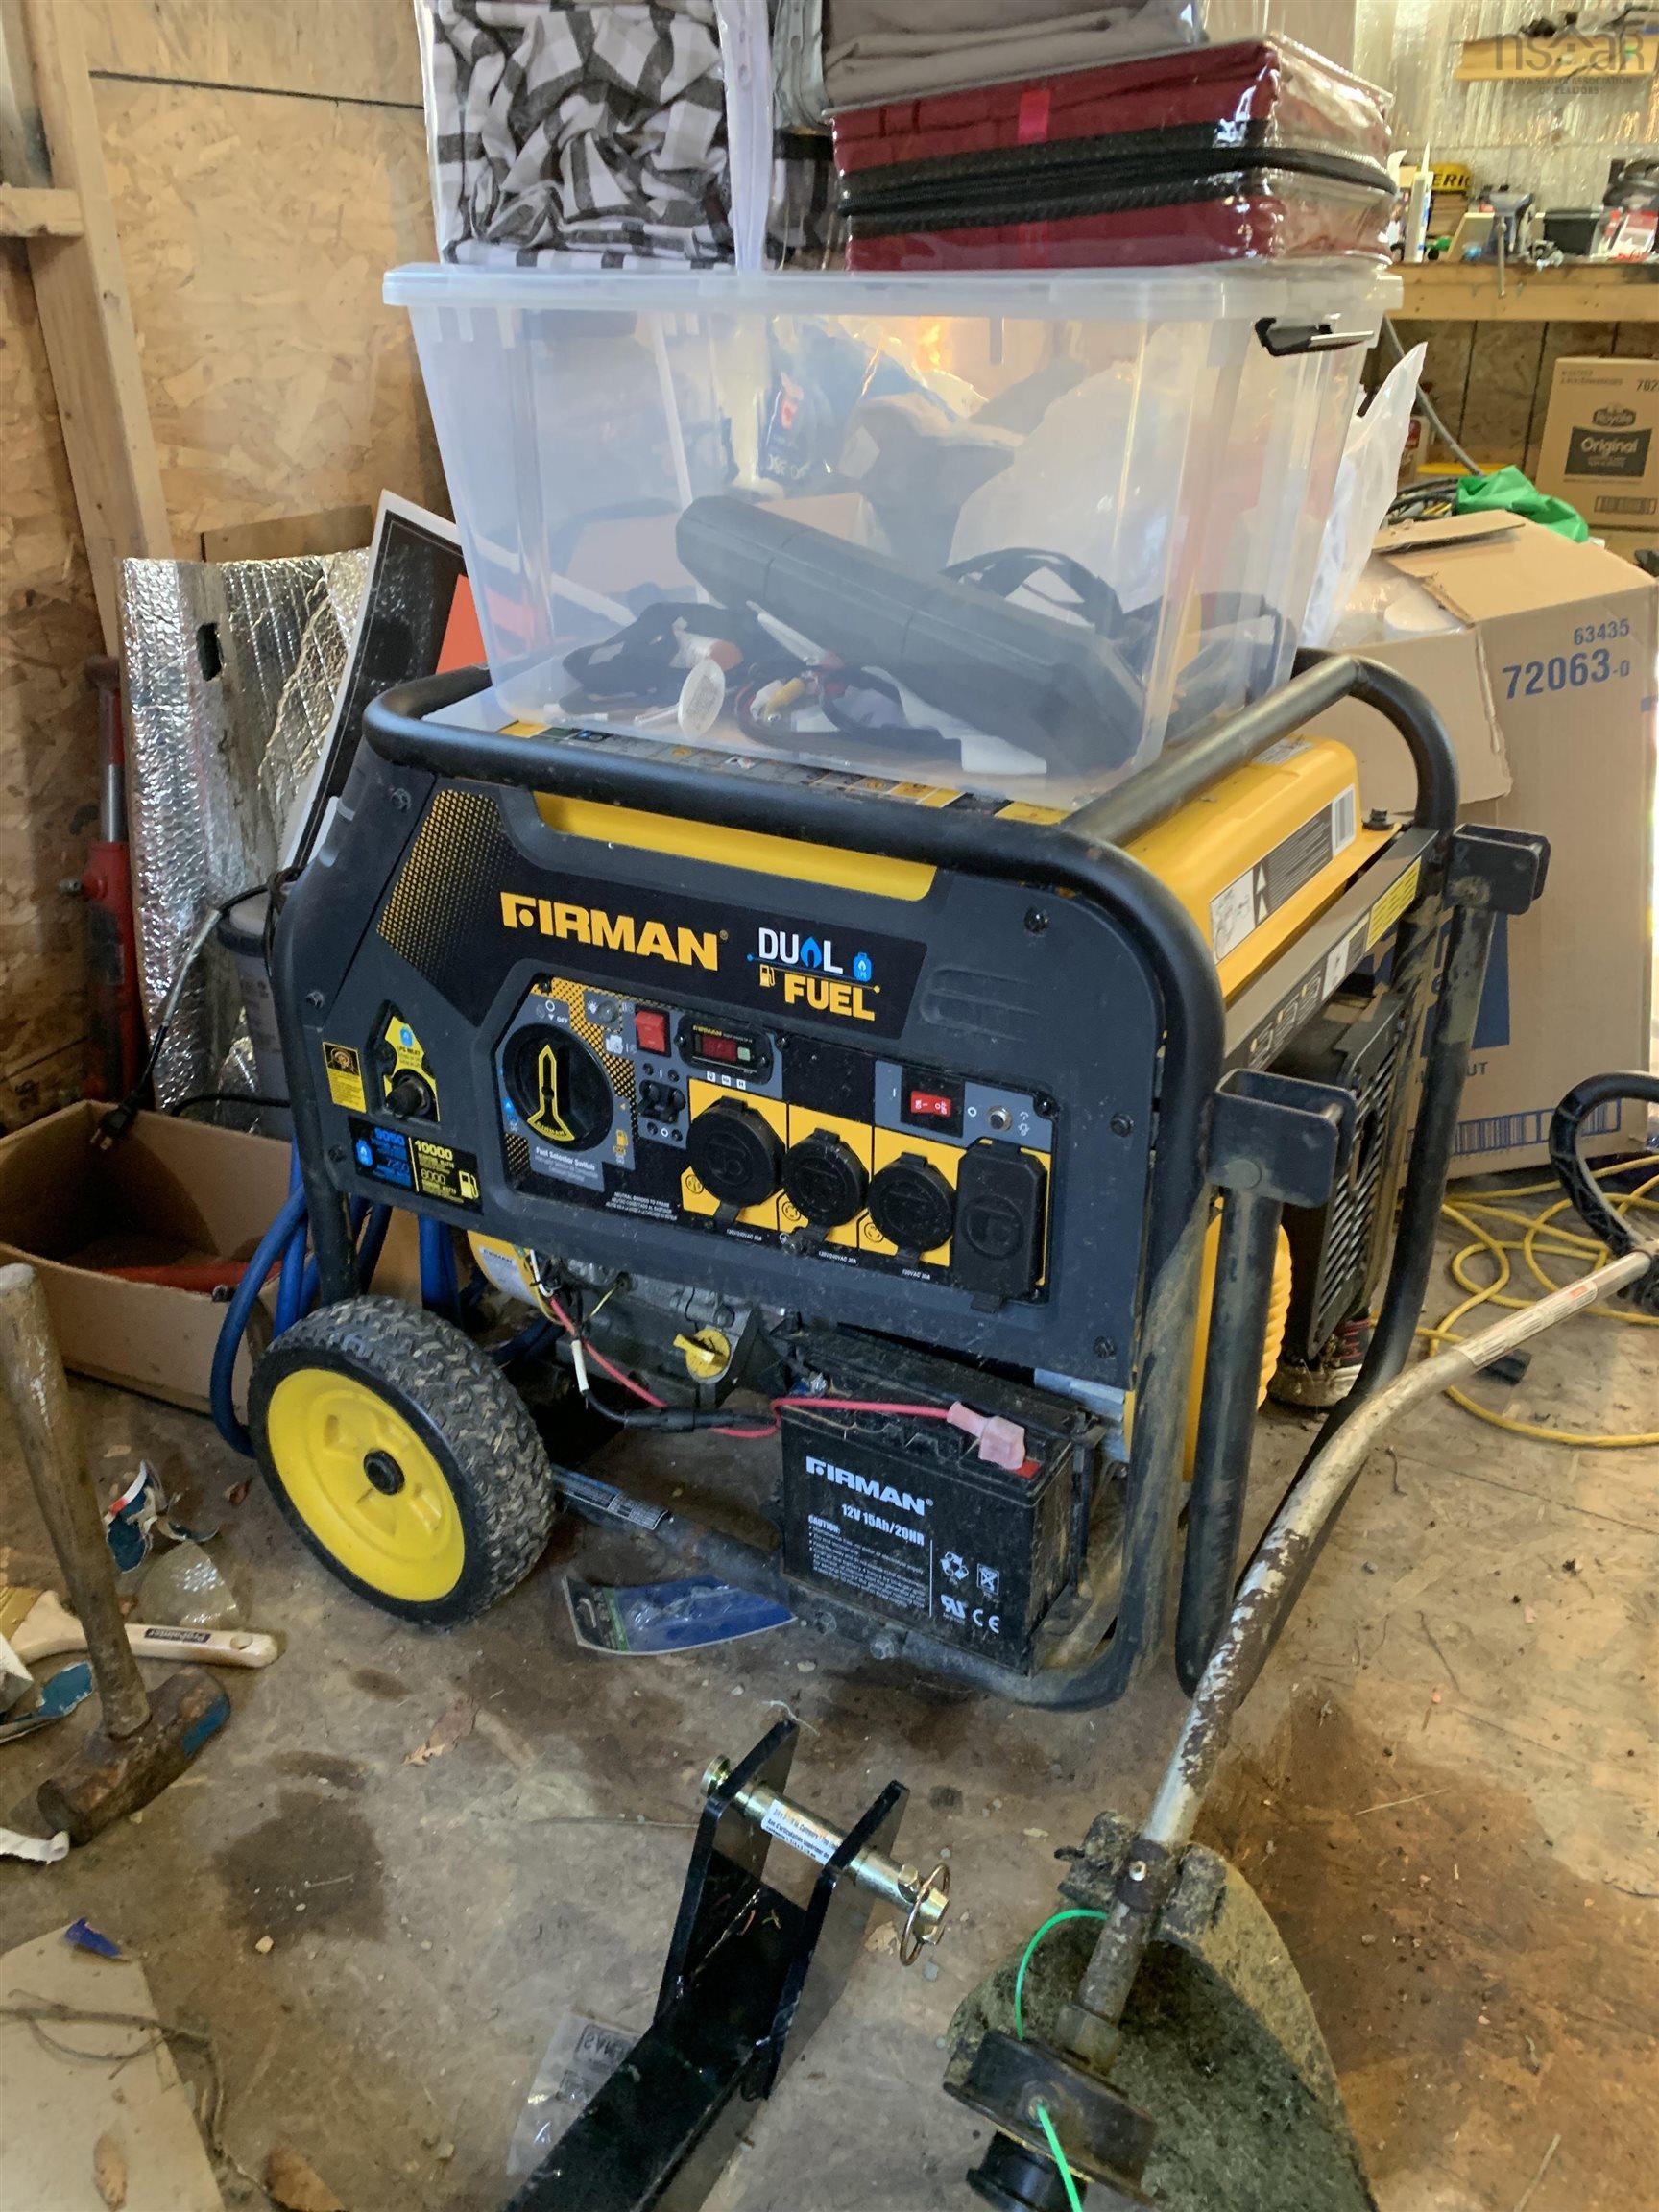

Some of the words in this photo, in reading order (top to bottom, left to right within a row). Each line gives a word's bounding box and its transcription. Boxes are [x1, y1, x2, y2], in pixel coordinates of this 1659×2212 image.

[1581, 436, 1639, 457] Original
[1574, 618, 1630, 646] 63435
[500, 891, 718, 972] FIRMAN
[758, 926, 844, 974] DUAL
[784, 973, 876, 1022] FUEL
[549, 1150, 574, 1166] Selector
[574, 1157, 596, 1171] Switch
[805, 1455, 926, 1516] FIRMAN
[841, 1503, 861, 1522] 12V
